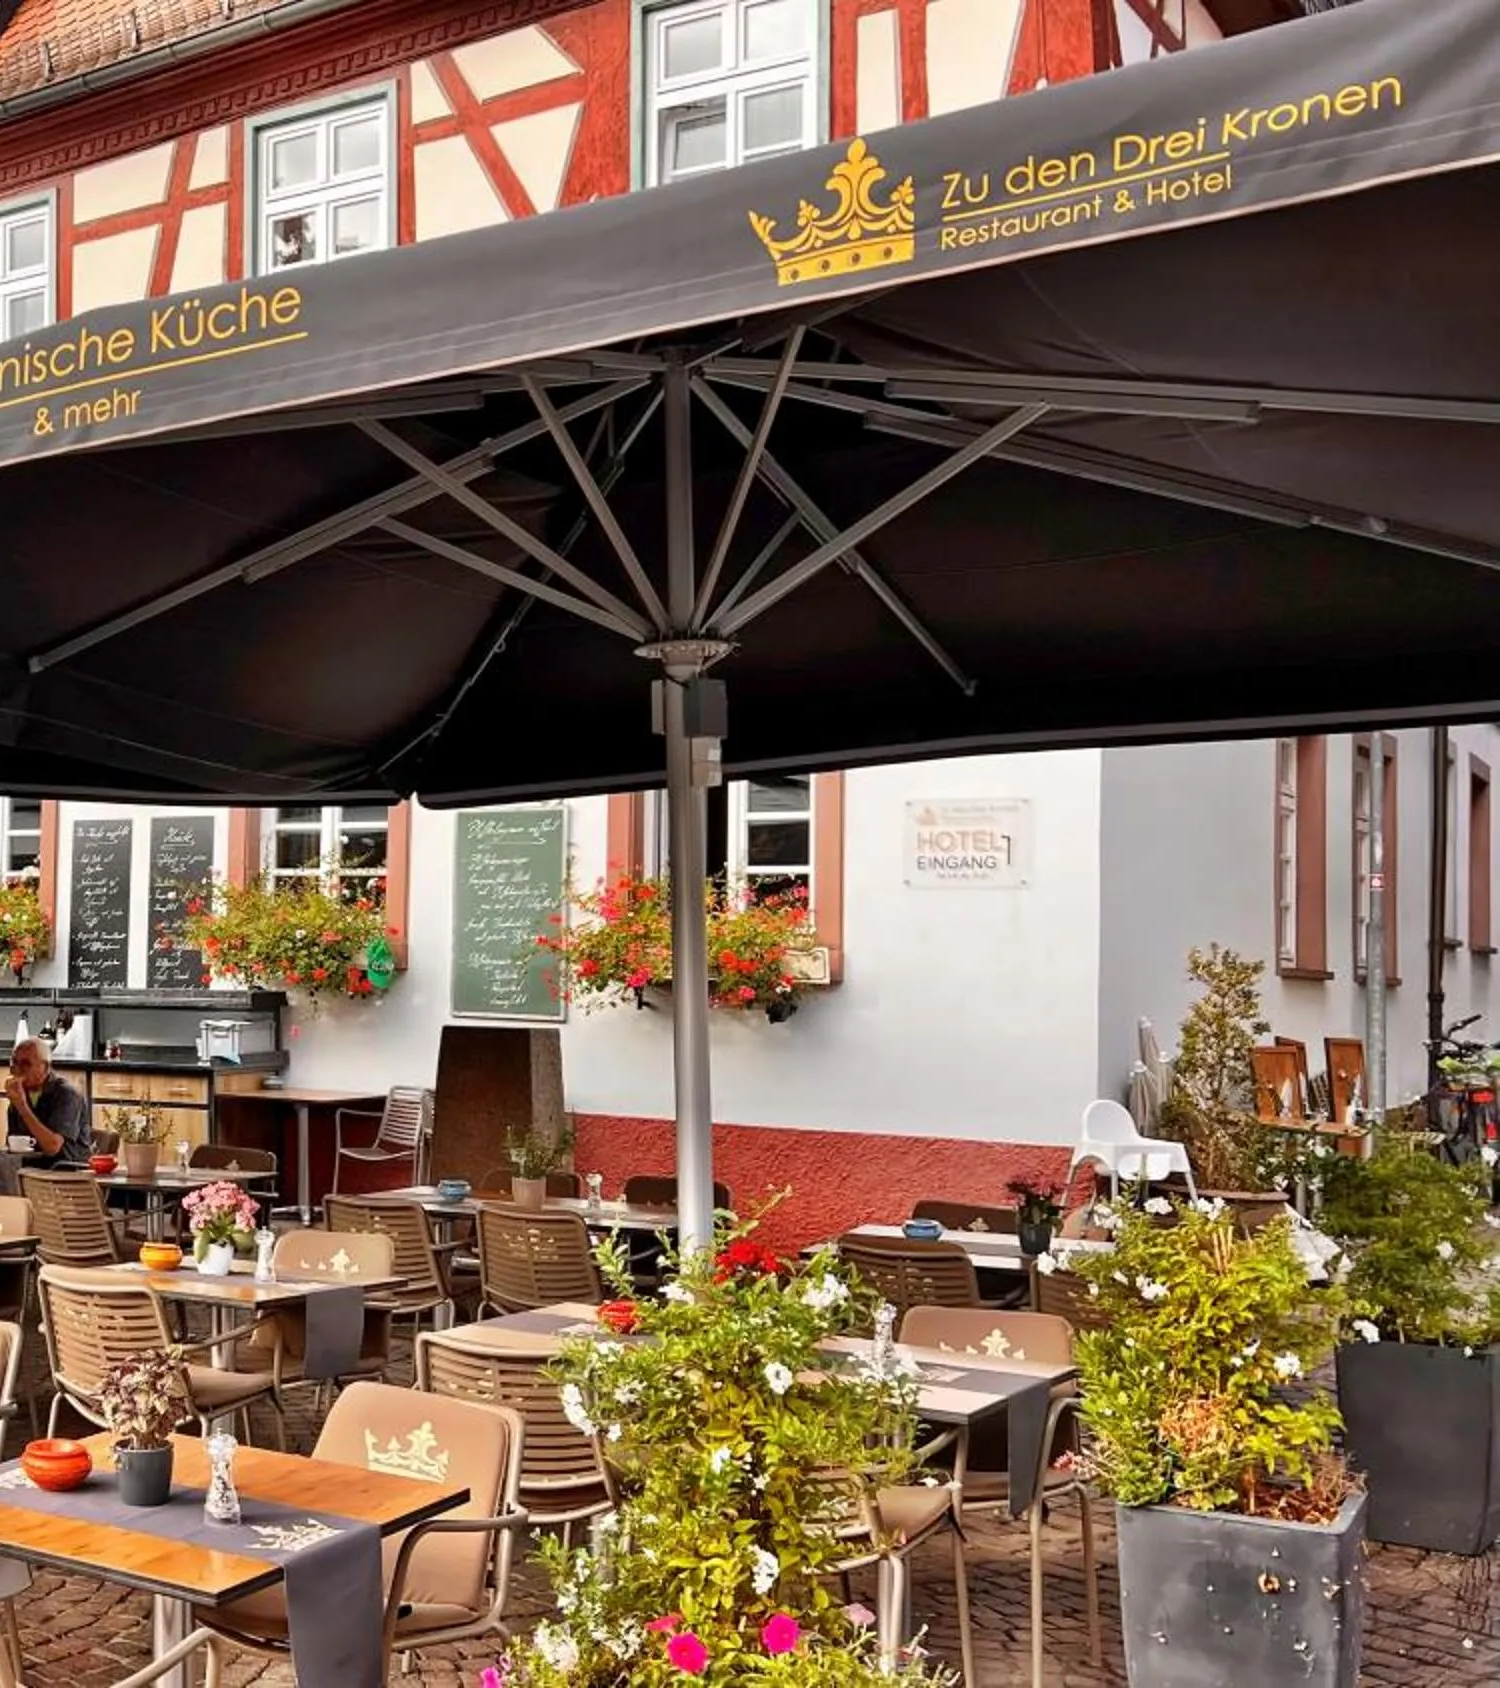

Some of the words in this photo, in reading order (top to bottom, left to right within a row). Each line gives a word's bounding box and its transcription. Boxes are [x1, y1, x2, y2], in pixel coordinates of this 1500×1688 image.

[941, 173, 990, 209] Zu
[1004, 150, 1095, 196] den
[1113, 118, 1206, 172] Drei
[1222, 75, 1402, 142] Kronen
[941, 194, 1103, 251] Restaurant
[1113, 187, 1136, 213] &
[1147, 165, 1232, 207] Hotel
[150, 286, 302, 354] Küche
[34, 406, 54, 435] &
[64, 387, 142, 429] mehr
[916, 830, 1004, 853] HOTEL
[916, 855, 998, 871] EINGANG
